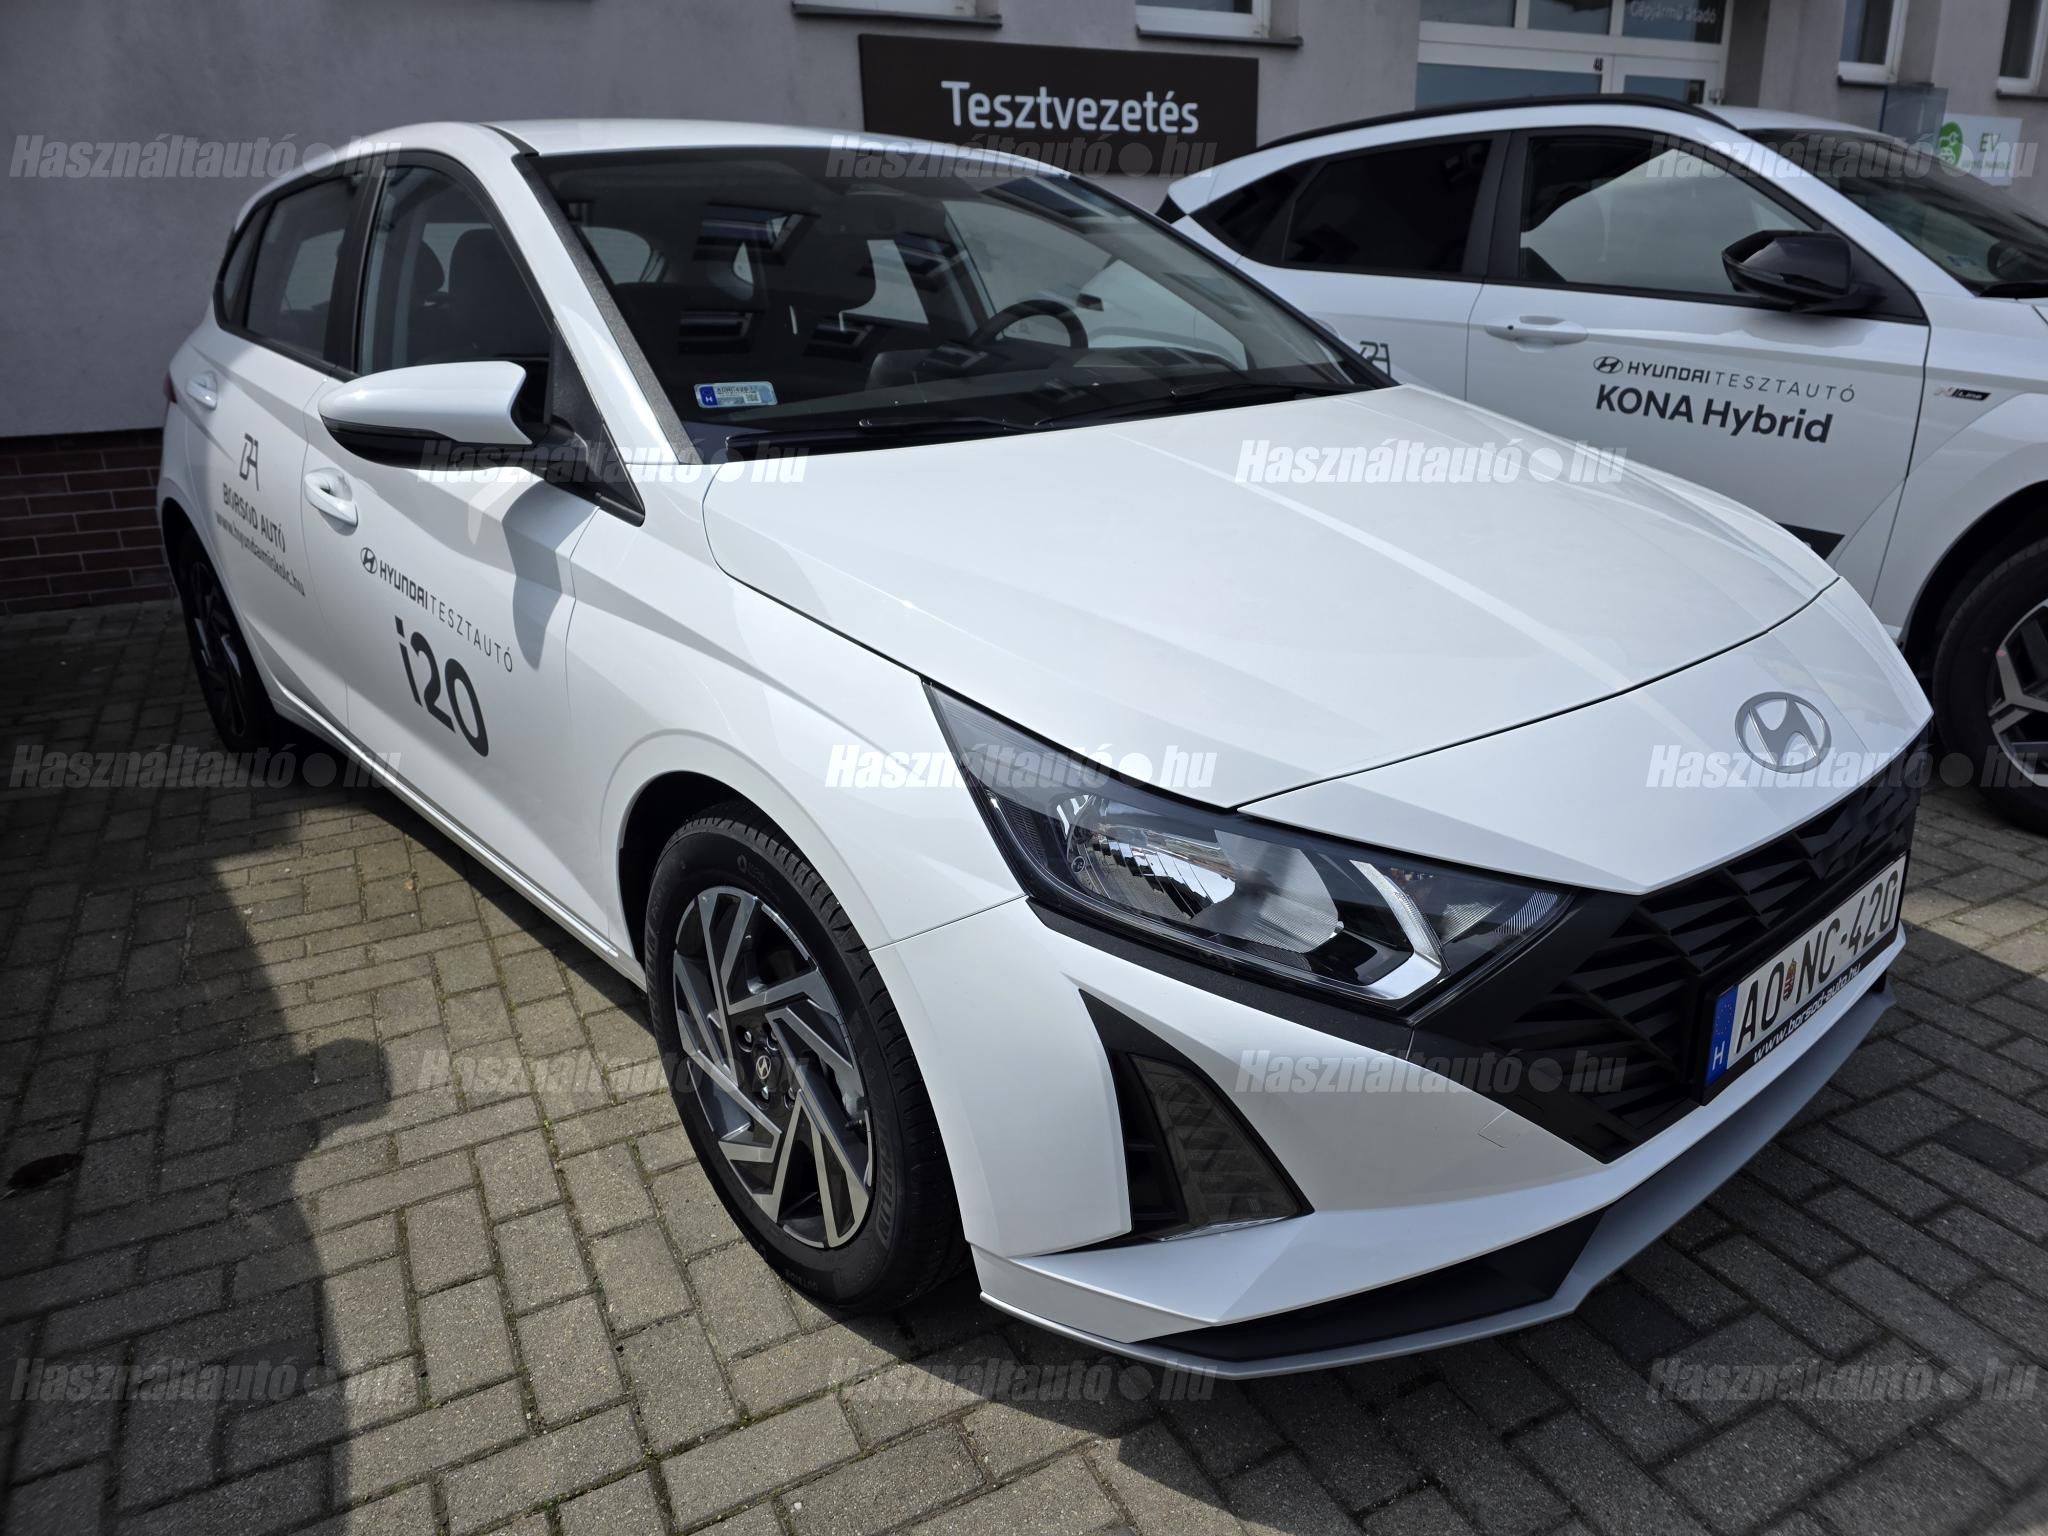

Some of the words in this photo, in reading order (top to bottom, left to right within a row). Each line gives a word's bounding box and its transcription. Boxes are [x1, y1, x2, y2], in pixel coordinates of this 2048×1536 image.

[941, 80, 1200, 134] Tesztvezetés
[1595, 384, 1694, 424] KONA
[1702, 398, 1834, 443] Hybrid
[1627, 361, 1711, 384] HYUNDAI
[1715, 371, 1856, 403] TESZTAUTÓ
[222, 482, 258, 531] BORSOD
[261, 513, 286, 553] AUTÓ
[380, 560, 428, 610] HYUNDAI
[430, 594, 513, 673] TESZTAUTÓ
[395, 615, 489, 757] i20
[1796, 869, 1898, 1004] NC-420
[1753, 962, 1861, 1063] www.borsod-auto.hu
[1712, 1041, 1726, 1071] H
